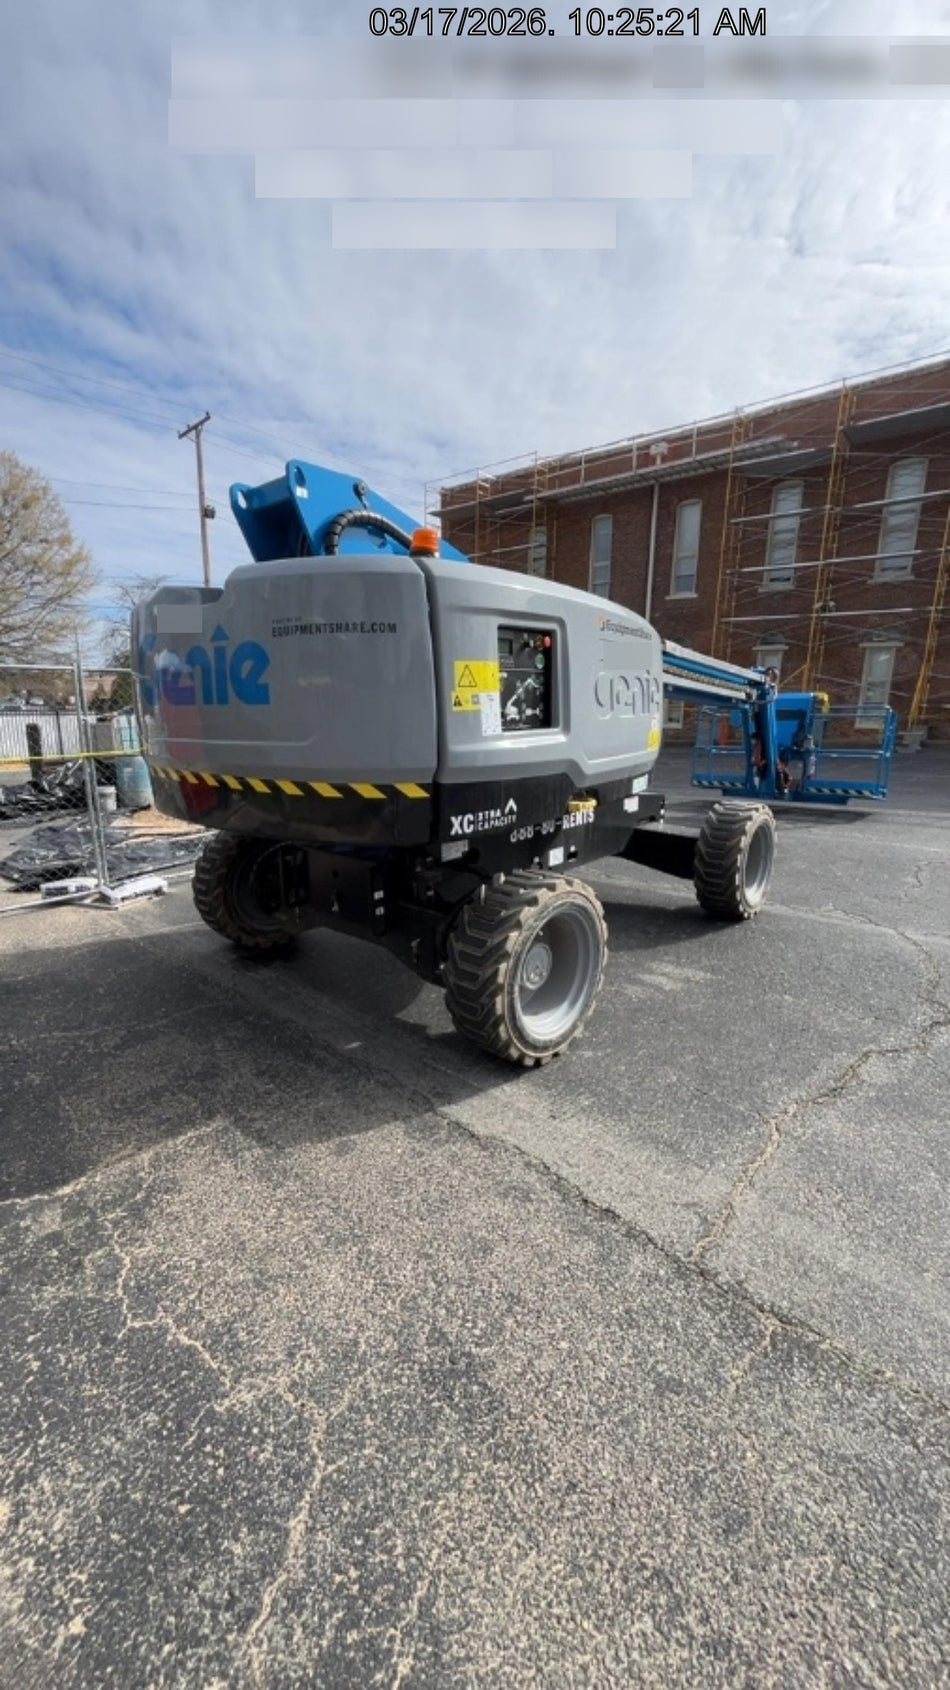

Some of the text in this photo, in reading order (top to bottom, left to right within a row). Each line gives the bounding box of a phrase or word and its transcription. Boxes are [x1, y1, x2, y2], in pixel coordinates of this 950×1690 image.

[271, 622, 398, 637] EQUIPMENTSHARE.COM
[450, 814, 475, 836] XC
[478, 814, 517, 831] CAPACITY
